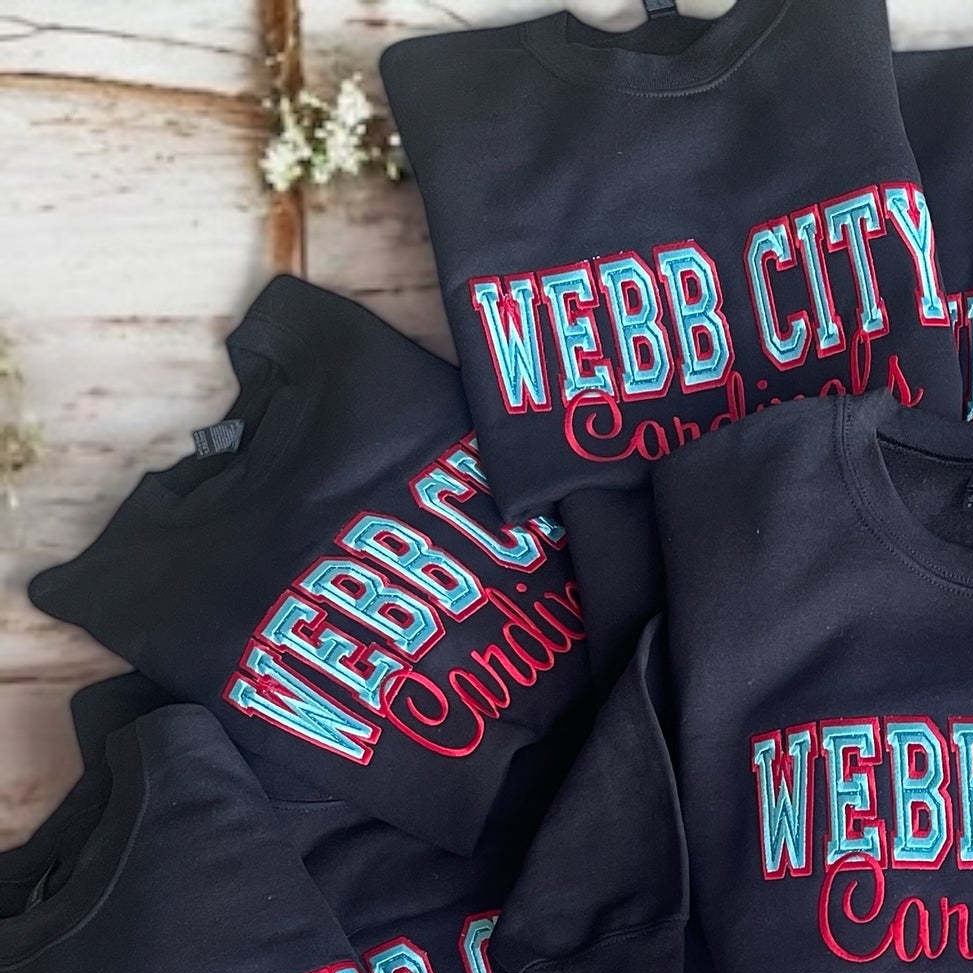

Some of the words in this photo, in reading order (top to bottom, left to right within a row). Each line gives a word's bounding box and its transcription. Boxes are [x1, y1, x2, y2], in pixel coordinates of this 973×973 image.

[468, 240, 734, 415] WEBB
[743, 181, 950, 371] CITY
[221, 510, 494, 767] WEBB
